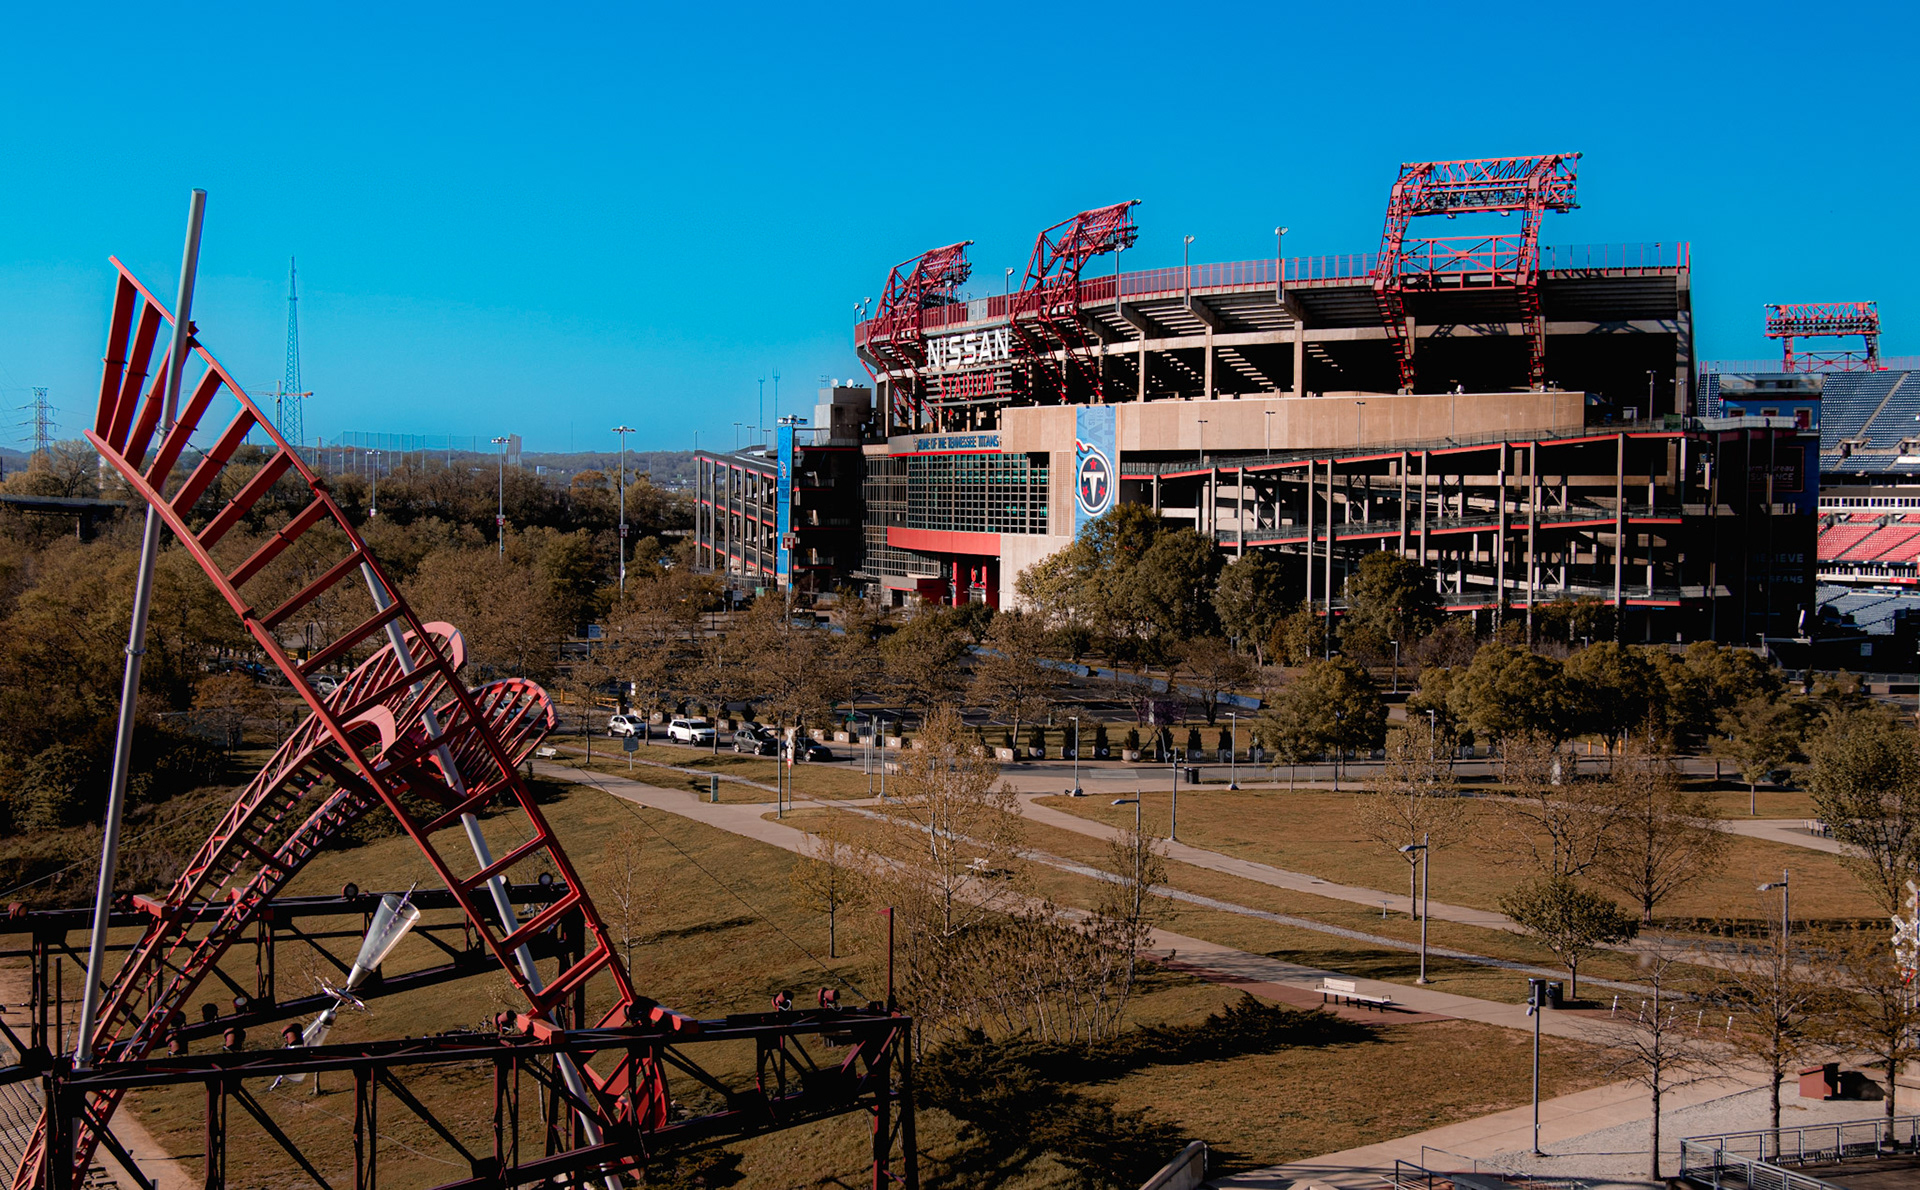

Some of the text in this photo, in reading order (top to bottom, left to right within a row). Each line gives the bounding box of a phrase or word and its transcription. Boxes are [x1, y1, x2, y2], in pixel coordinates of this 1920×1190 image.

[927, 328, 1009, 368] NISSAN
[940, 372, 995, 398] STADIUM
[947, 436, 976, 448] TENNESSEE
[978, 435, 999, 448] TITANS
[784, 538, 794, 548] H
